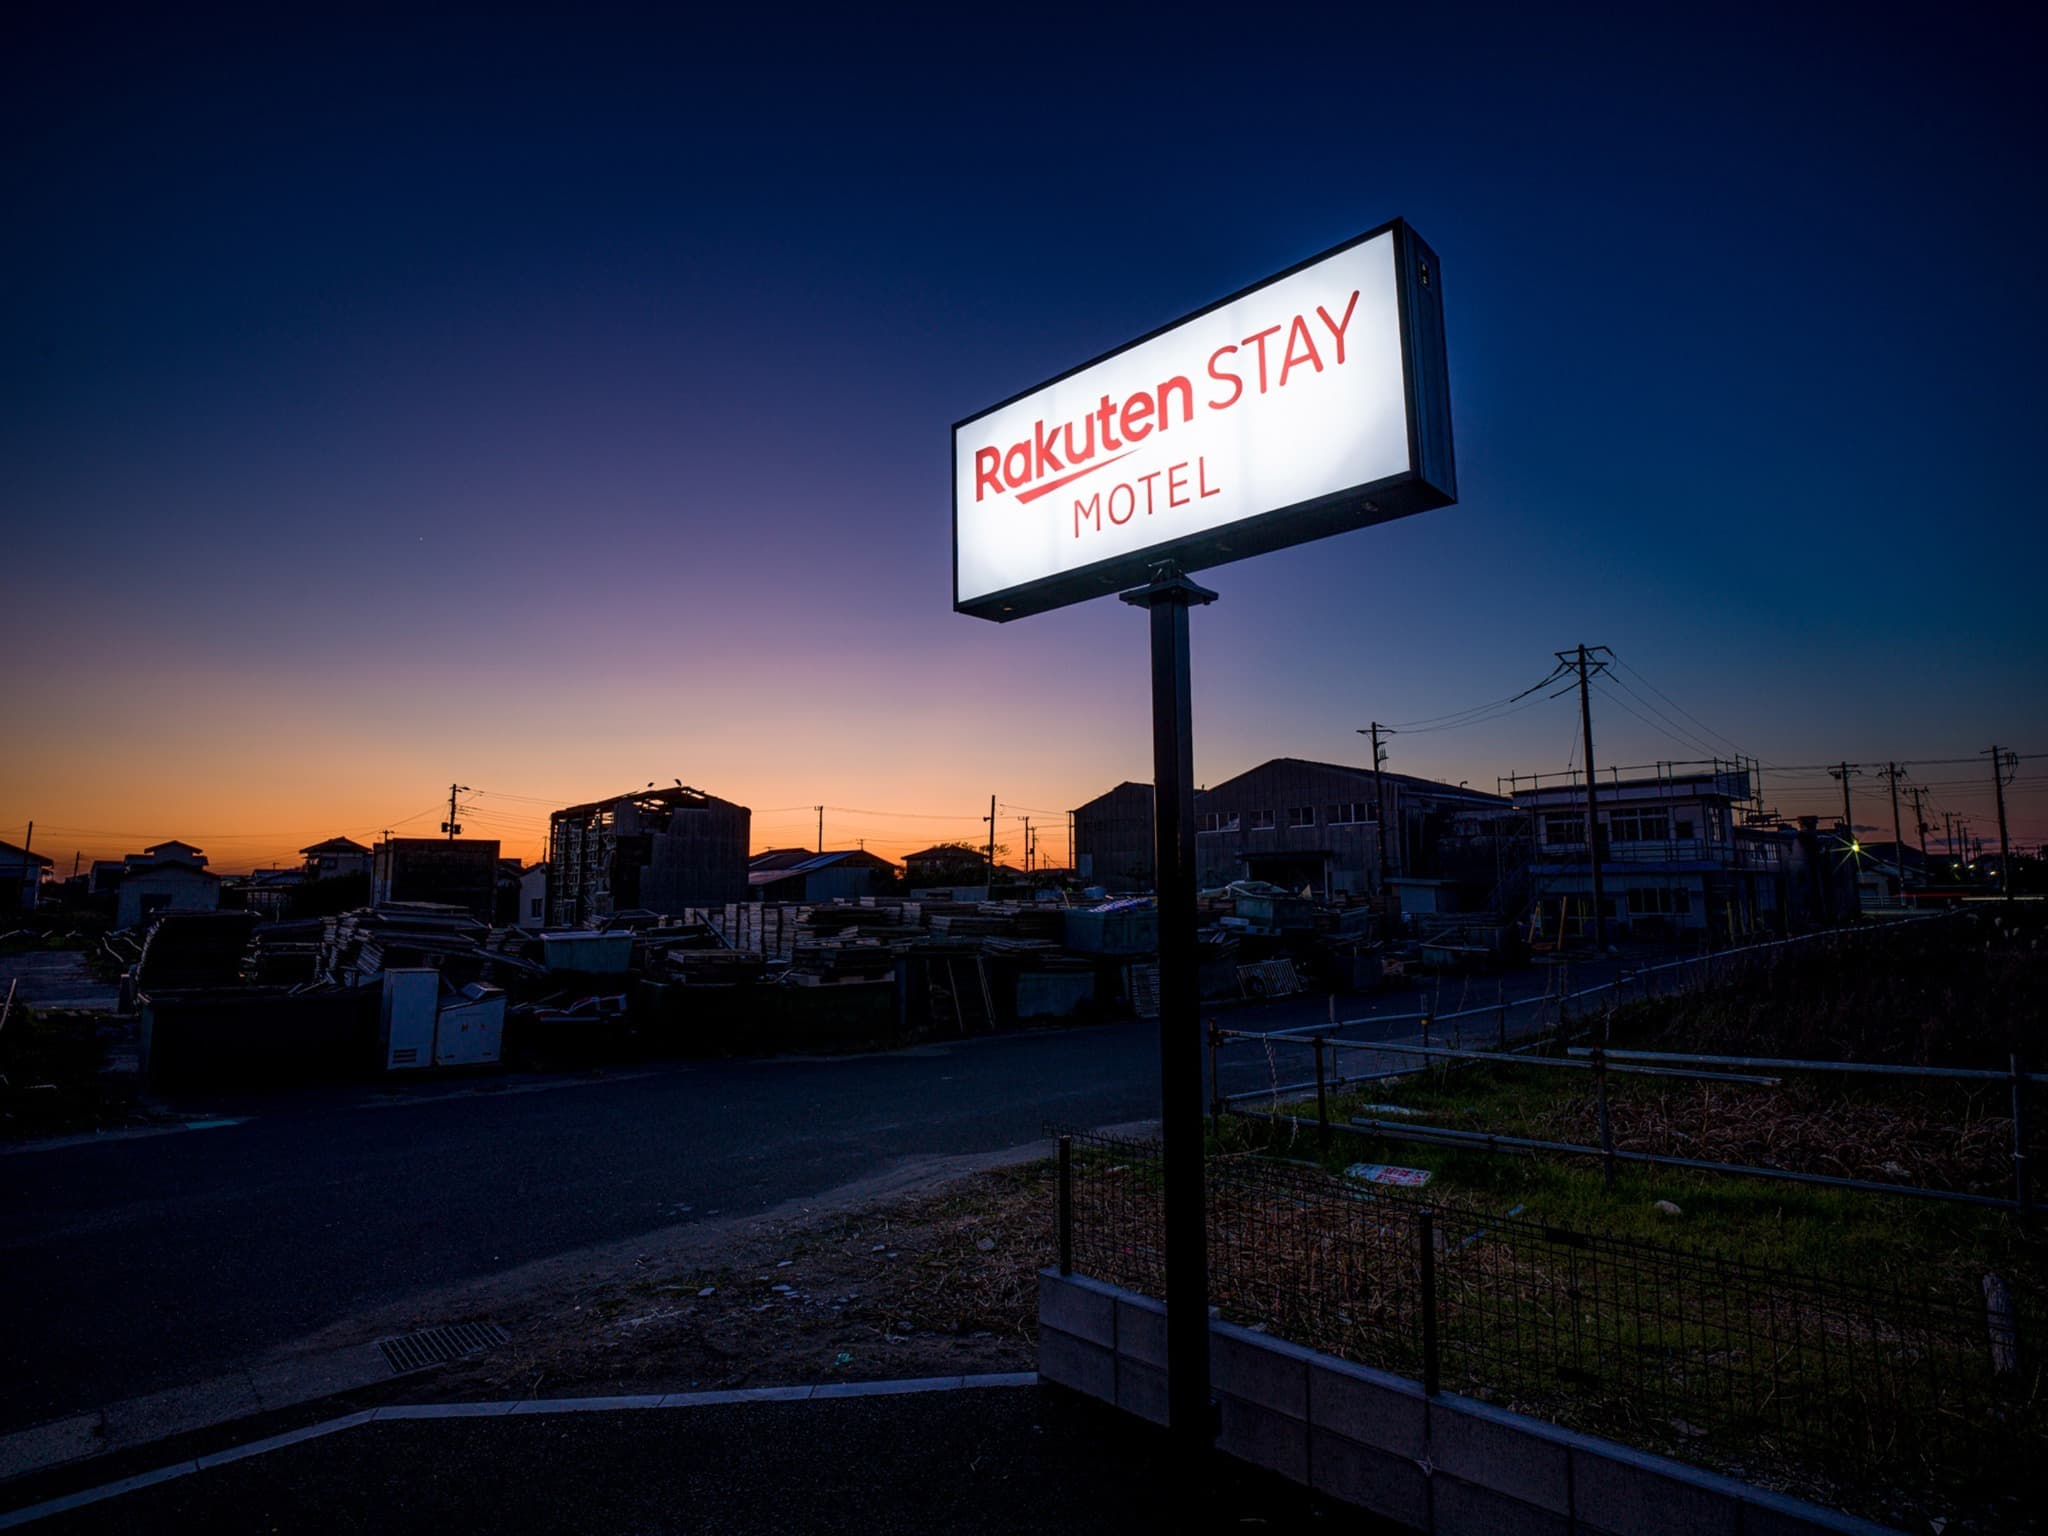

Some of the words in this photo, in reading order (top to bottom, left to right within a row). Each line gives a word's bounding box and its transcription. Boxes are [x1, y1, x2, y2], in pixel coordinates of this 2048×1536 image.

[975, 375, 1194, 503] Rakuten
[1207, 291, 1359, 411] STAY
[1074, 456, 1220, 538] MOTEL
